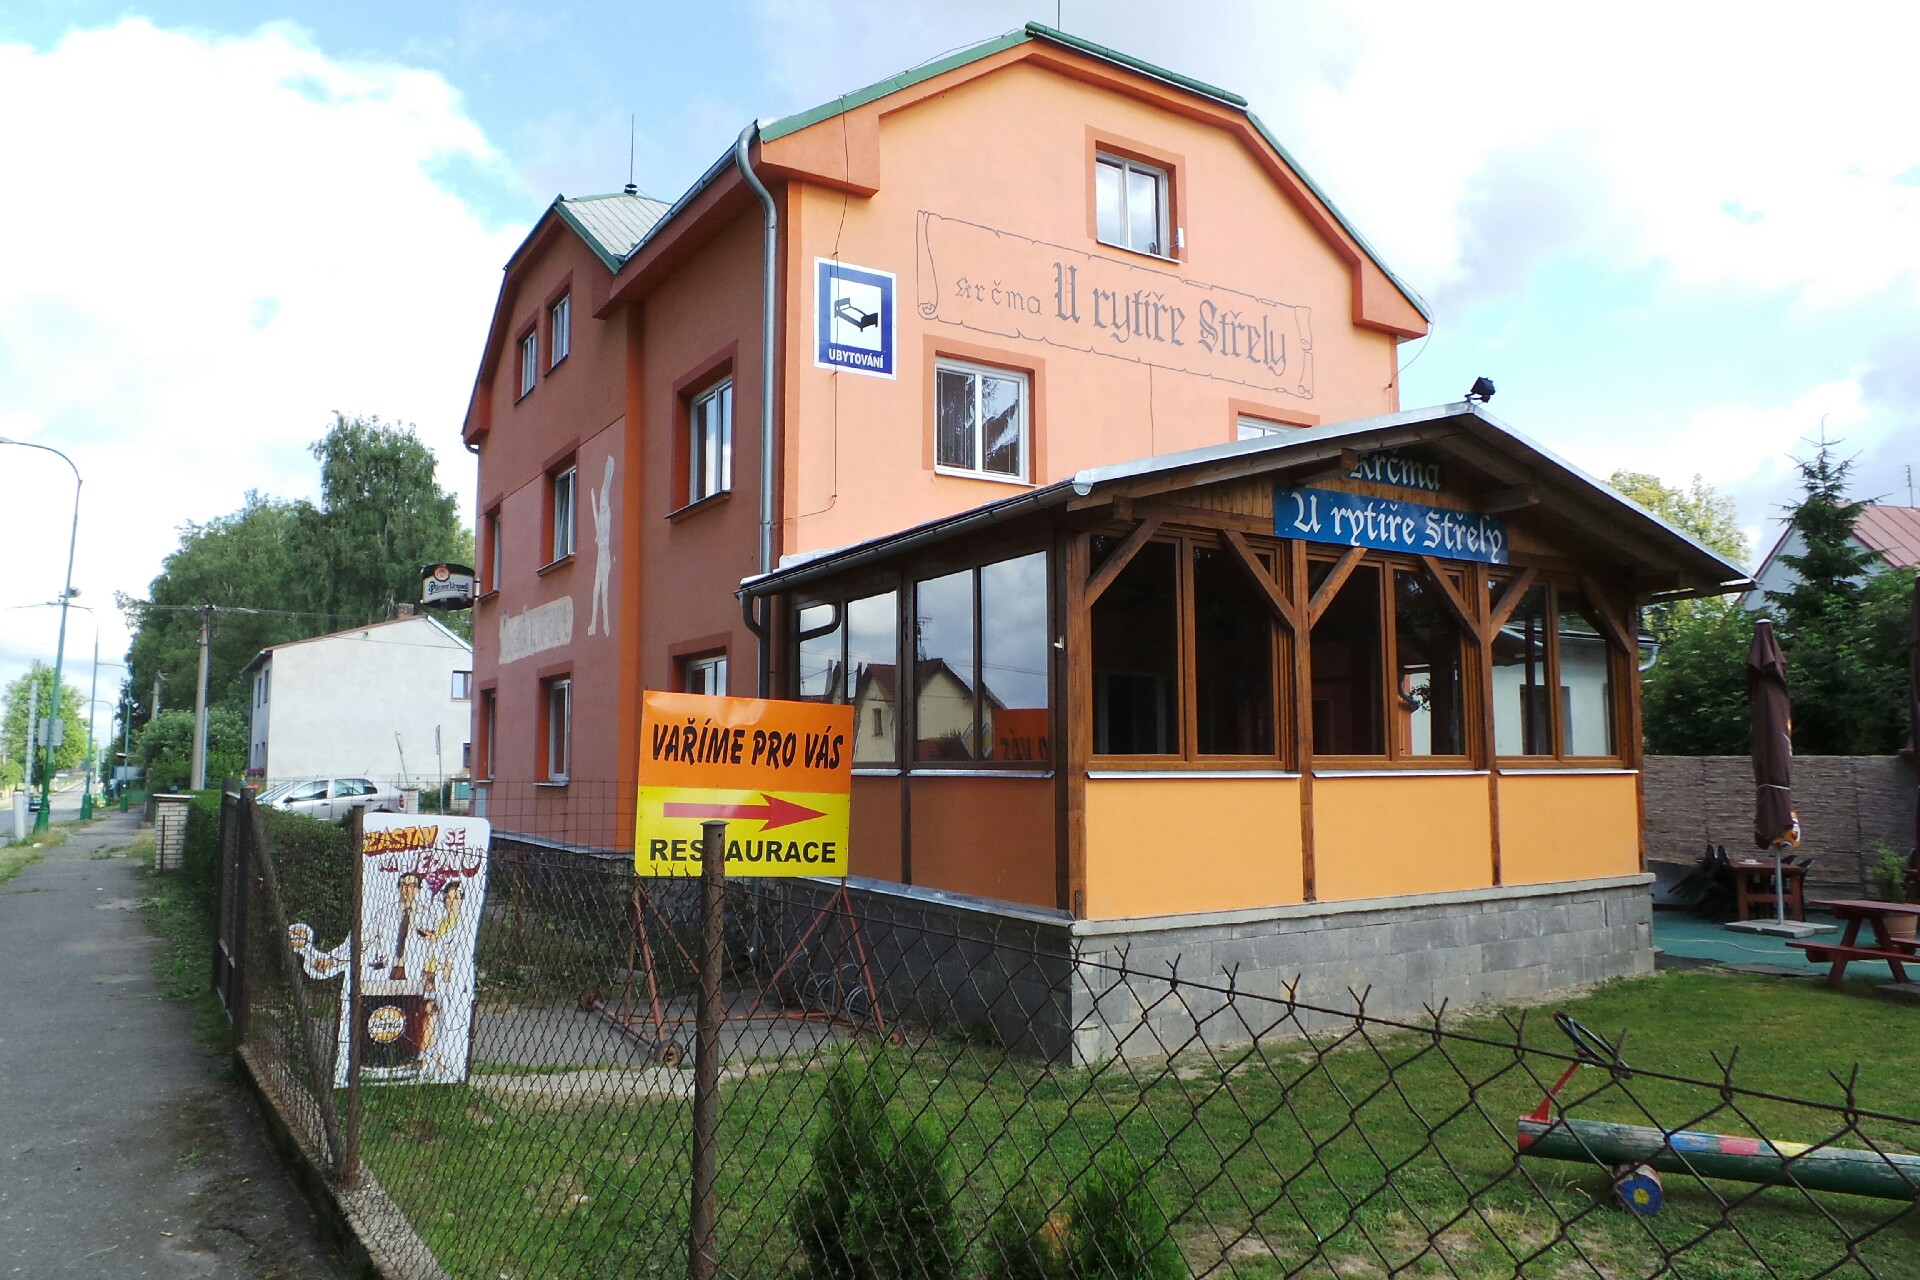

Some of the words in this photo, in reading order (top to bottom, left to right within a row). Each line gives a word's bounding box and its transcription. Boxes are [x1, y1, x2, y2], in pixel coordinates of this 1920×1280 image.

[828, 347, 884, 369] UBYTOVÁNÍ
[1291, 491, 1321, 534] U
[1331, 501, 1416, 547] rytíře
[1423, 511, 1502, 563] Střely
[652, 717, 746, 766] VAŘÍME
[751, 729, 797, 770] PRO
[804, 725, 844, 770] VÁS
[444, 826, 466, 847] SE
[649, 838, 837, 864] RESAURACE
